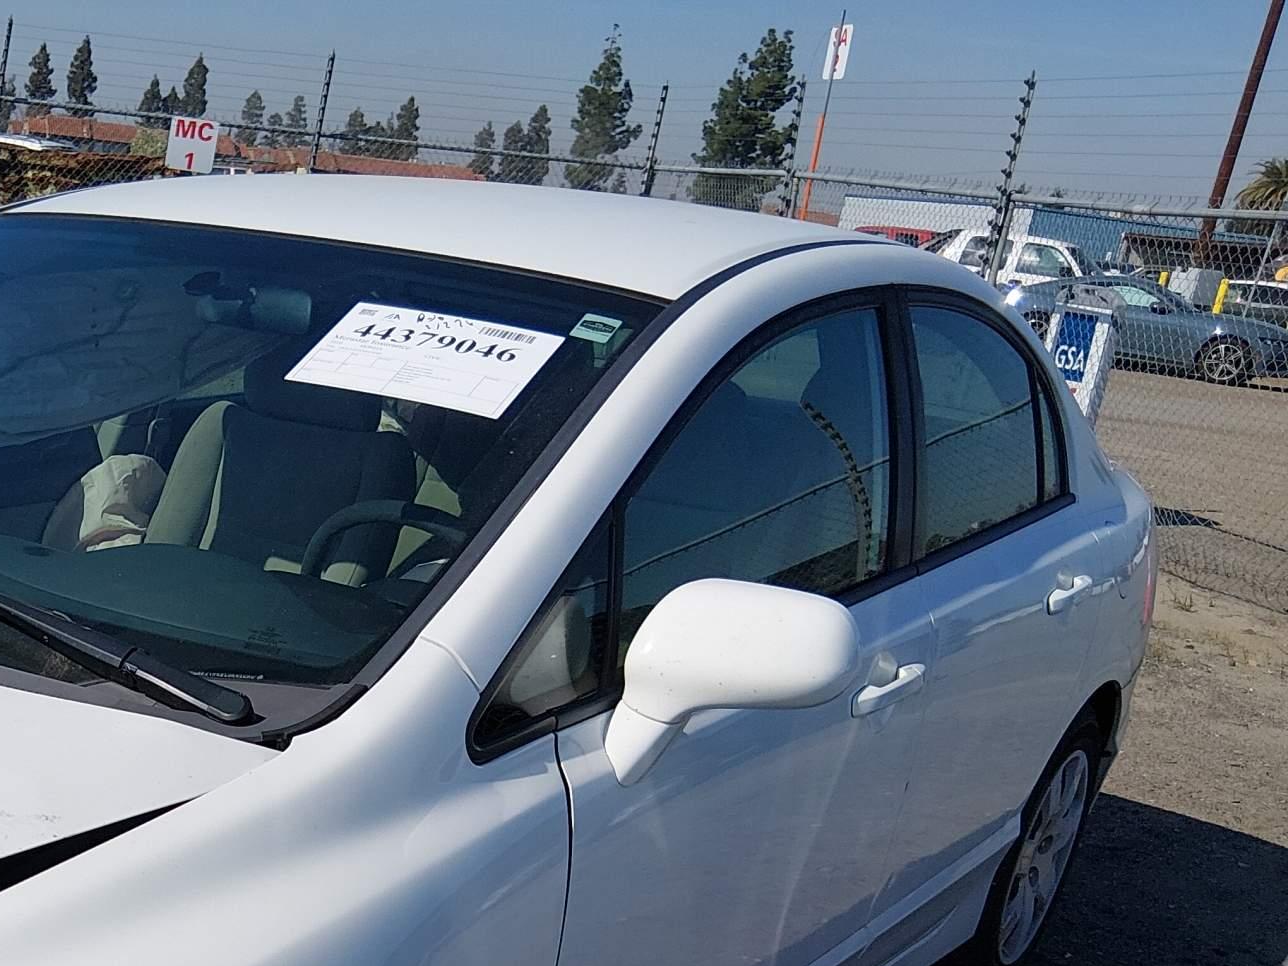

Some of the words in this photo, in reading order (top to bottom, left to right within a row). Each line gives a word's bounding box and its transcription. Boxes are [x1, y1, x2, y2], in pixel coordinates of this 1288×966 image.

[175, 119, 215, 142] MC
[184, 152, 194, 170] 1
[353, 323, 523, 363] 44379046
[1055, 344, 1085, 372] GSA
